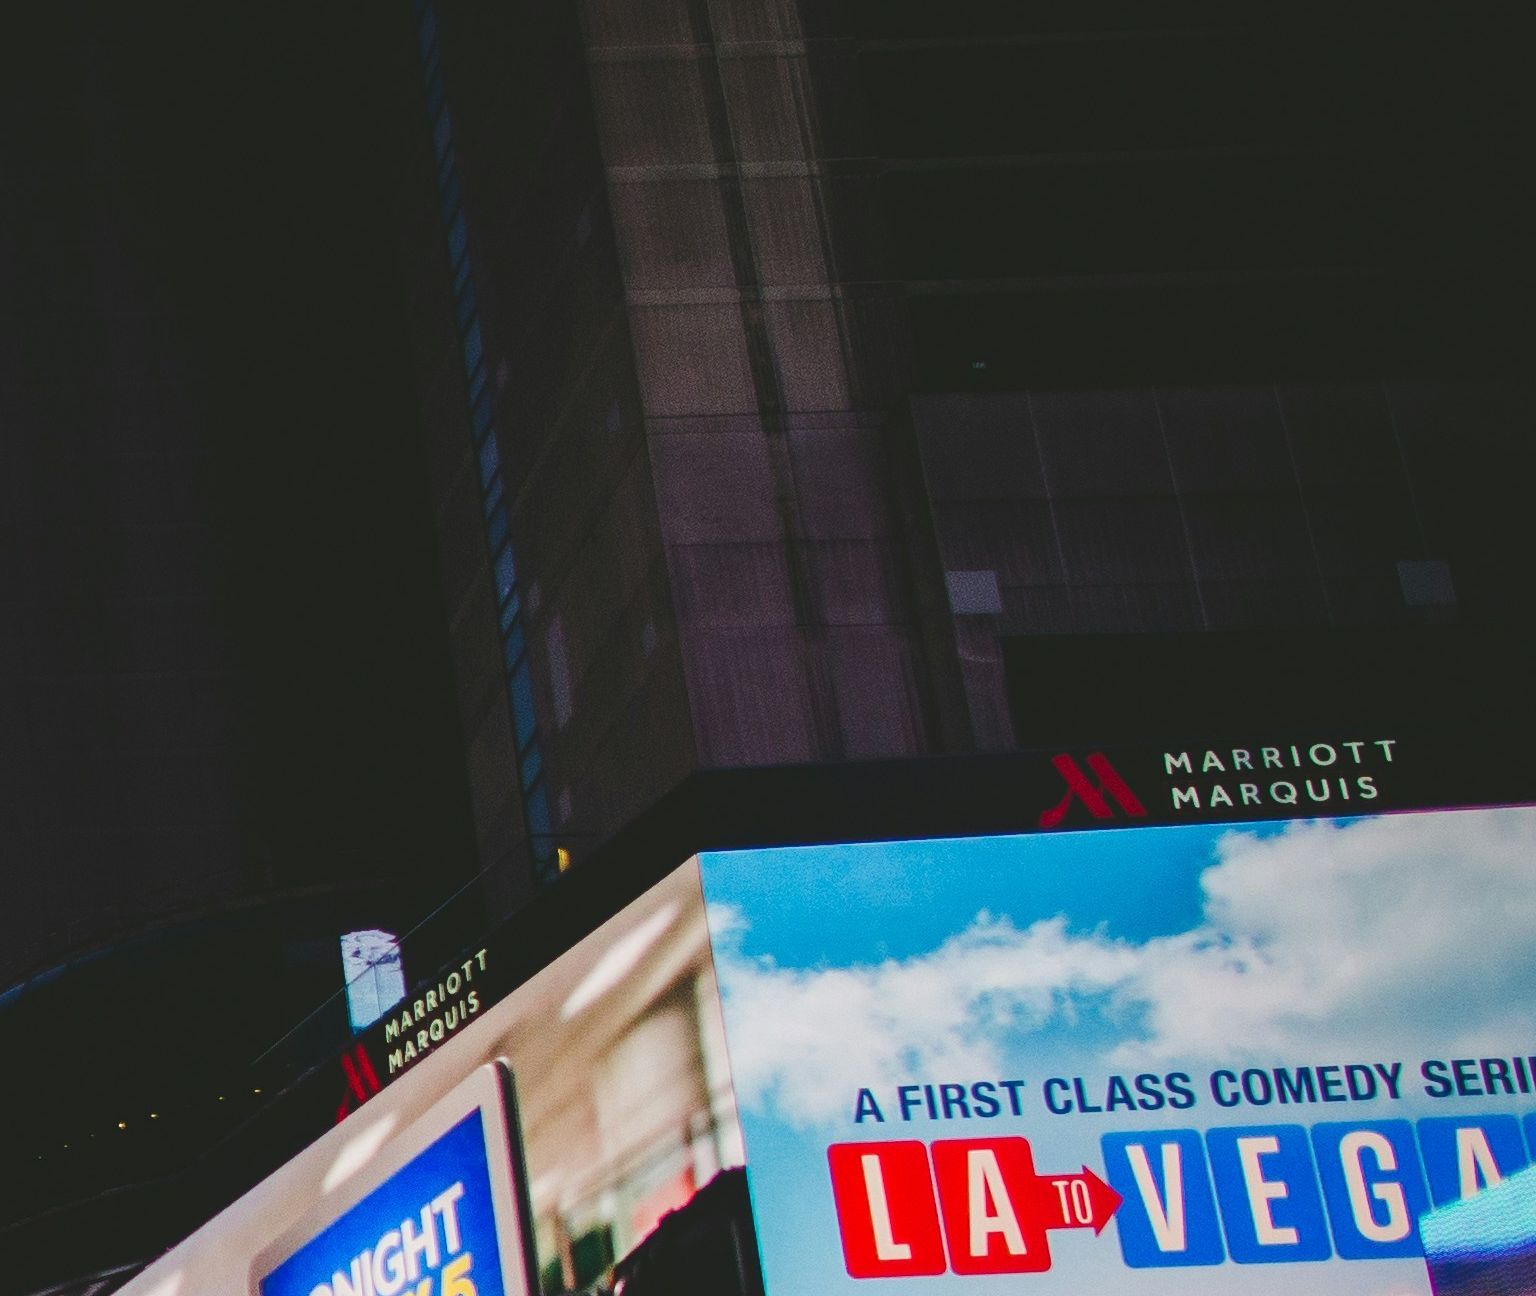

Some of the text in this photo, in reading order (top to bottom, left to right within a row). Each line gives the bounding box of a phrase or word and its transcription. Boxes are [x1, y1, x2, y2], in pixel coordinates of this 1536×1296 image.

[1162, 739, 1399, 777] MARRIOTT
[1170, 776, 1381, 811] MARQUIS
[384, 948, 489, 1043] MARRIOTT
[388, 990, 481, 1075] MARQUIS
[853, 1055, 1536, 1124] A FIRST CLASS COMEDY SERI
[861, 1122, 1508, 1263] LA TO VEGA
